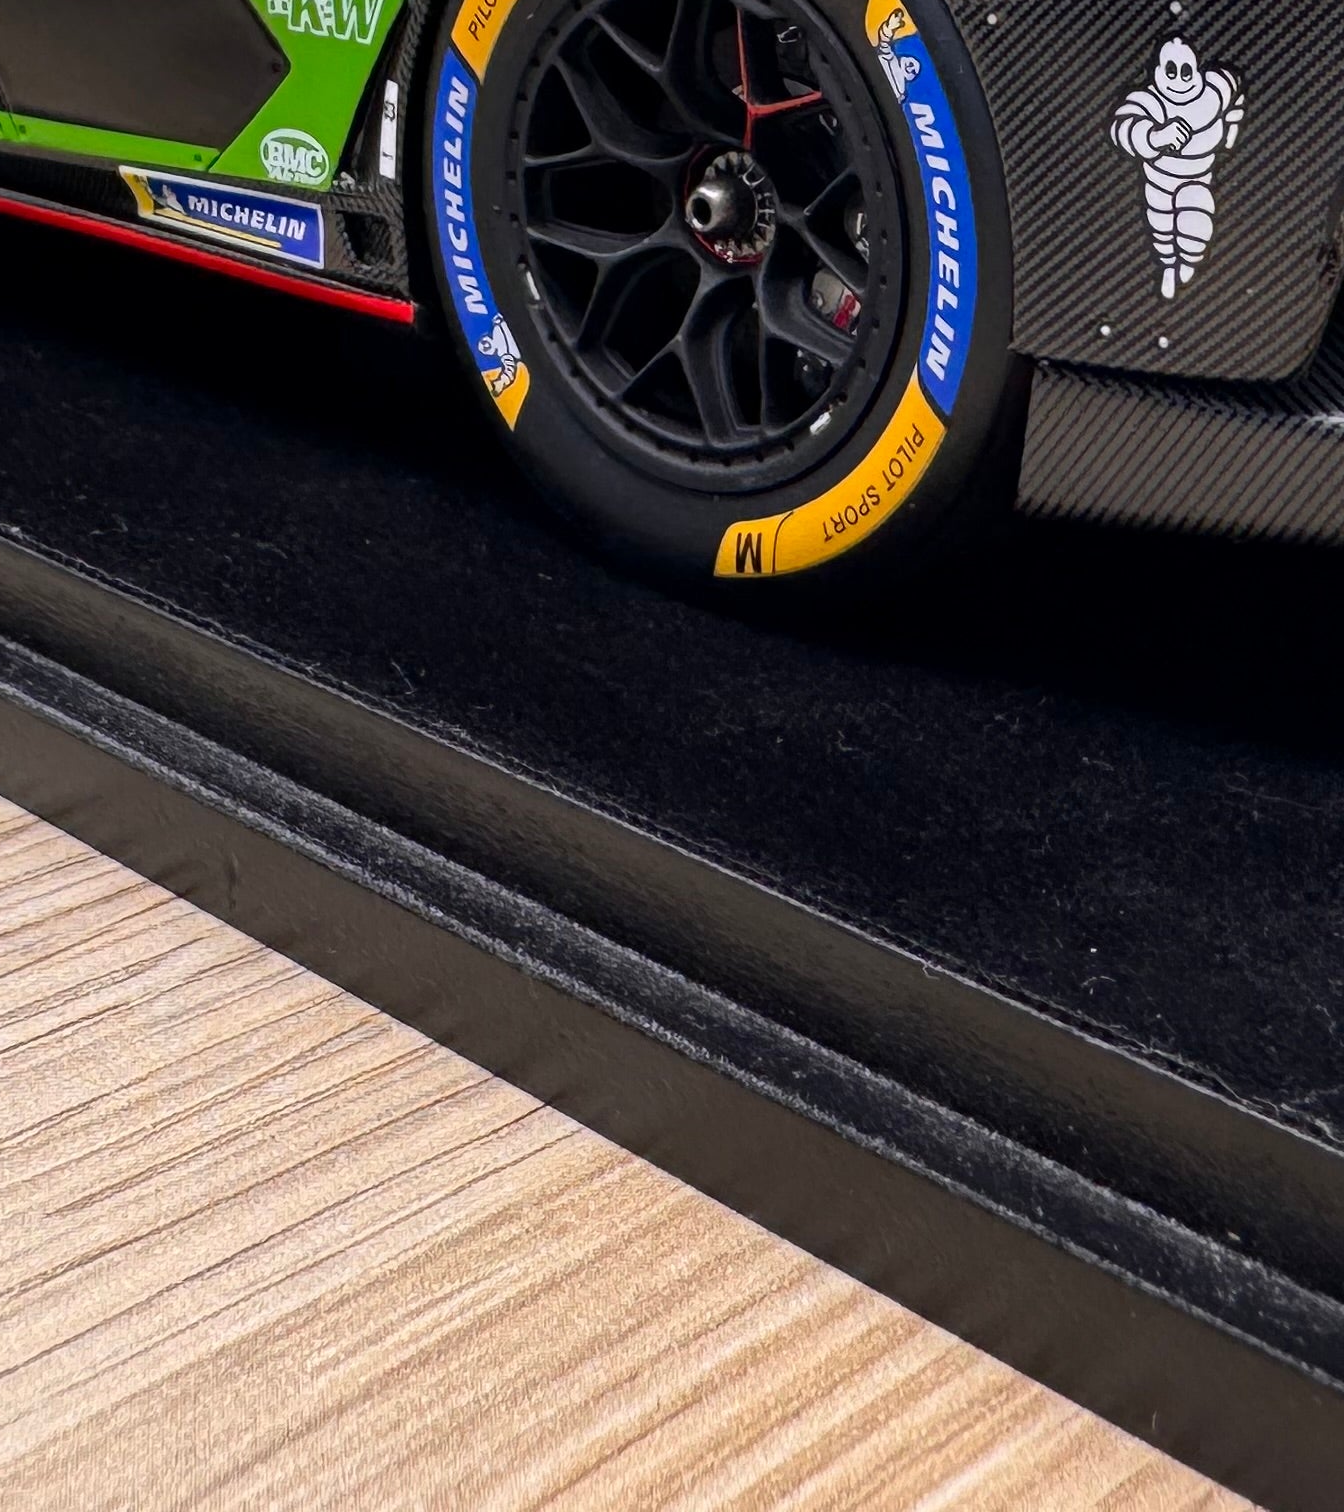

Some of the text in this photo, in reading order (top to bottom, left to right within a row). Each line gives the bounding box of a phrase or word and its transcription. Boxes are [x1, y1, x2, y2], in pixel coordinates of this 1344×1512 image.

[268, 141, 324, 178] BMC
[443, 75, 489, 316] MICHELIN
[188, 195, 307, 241] MICHELIN
[908, 101, 960, 382] MICHELIN
[821, 423, 925, 543] PILOT SPORT
[735, 532, 763, 574] M
